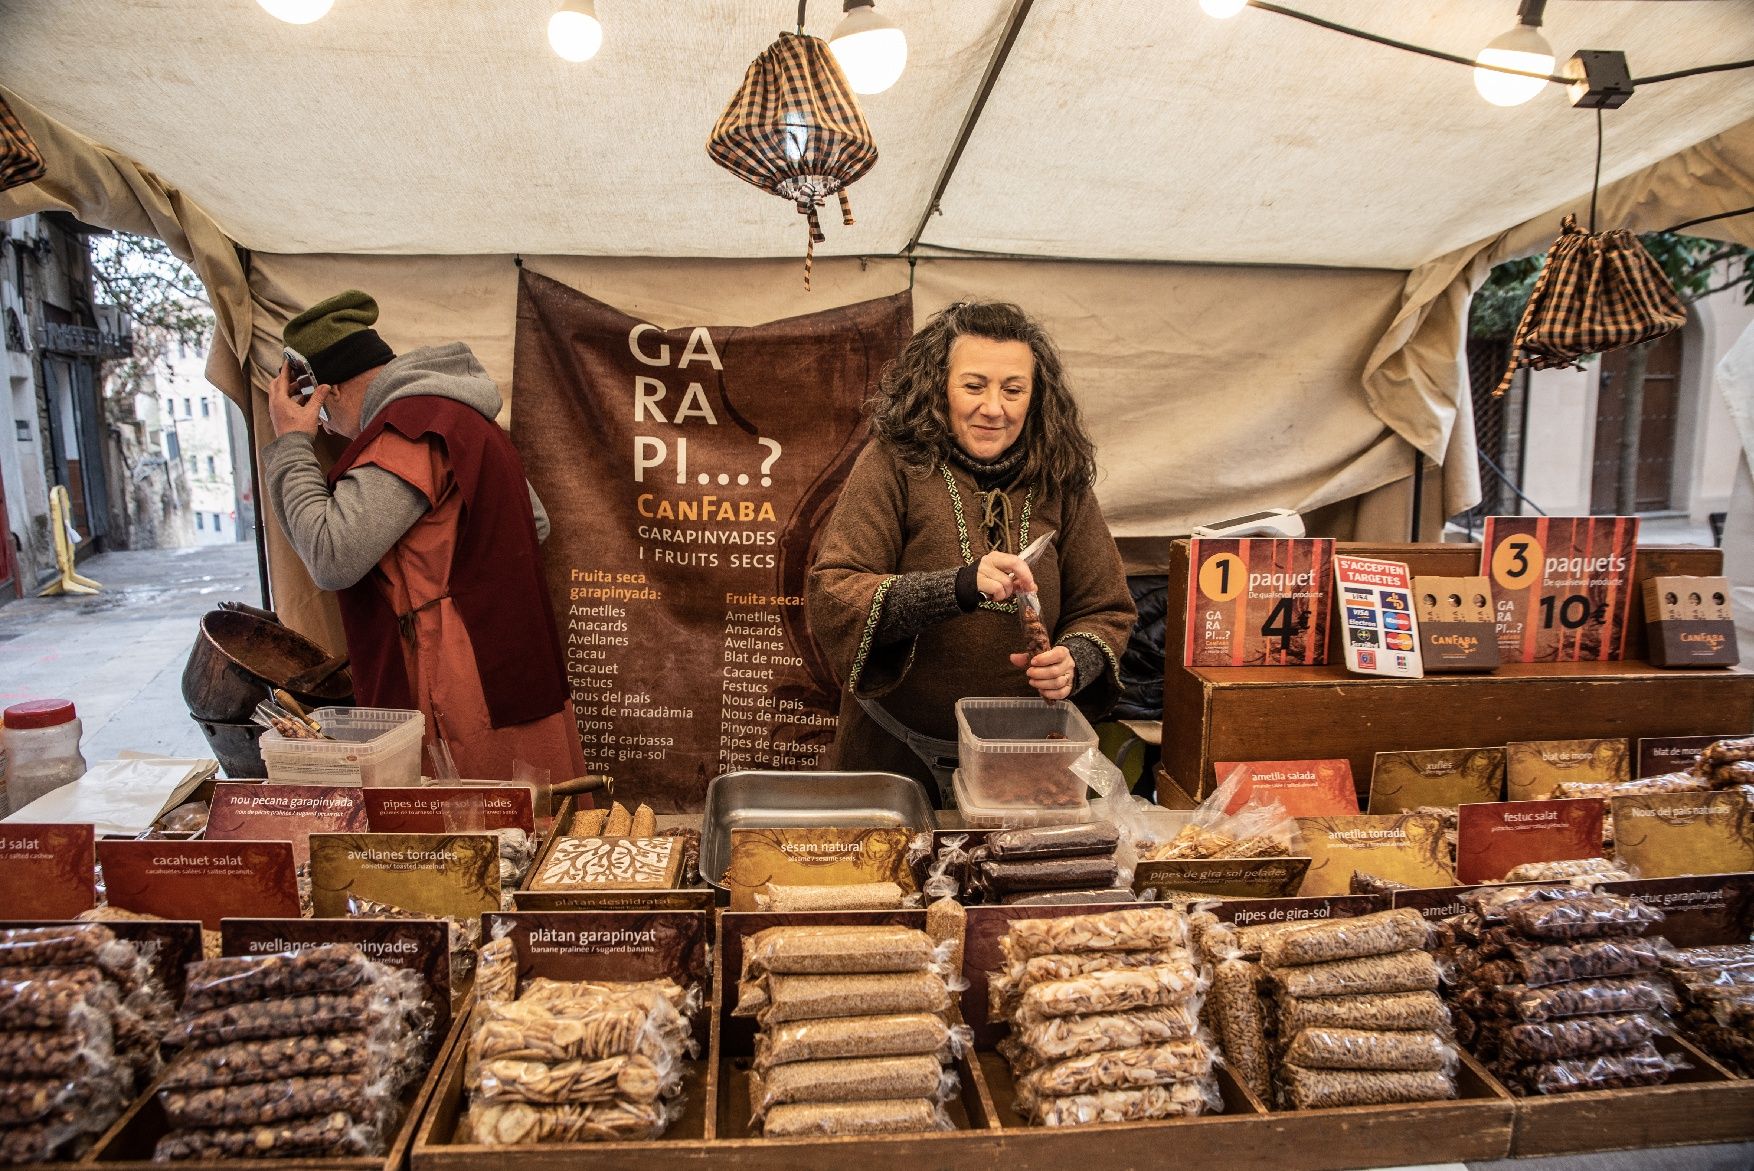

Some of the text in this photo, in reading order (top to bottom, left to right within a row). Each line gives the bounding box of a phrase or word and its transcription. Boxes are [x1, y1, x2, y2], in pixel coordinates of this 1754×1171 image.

[628, 323, 723, 370] GA
[634, 375, 718, 425] RA
[638, 525, 776, 545] GARAPINYADES
[655, 549, 719, 567] FRUITS
[730, 554, 776, 568] SECS
[1506, 543, 1626, 578] 3 paquets
[1340, 560, 1404, 575] S'ACCEPTEN
[571, 569, 646, 584] Fruita seca
[1216, 559, 1316, 594] 1 paquet
[1347, 571, 1401, 586] TARGETES
[1544, 579, 1554, 587] De
[569, 586, 661, 602] garapinyada:
[726, 592, 805, 606] Fruita seca:
[1292, 592, 1324, 600] producte
[569, 604, 626, 617] Ametlles
[1497, 600, 1515, 611] GA
[725, 611, 781, 623] Ametlles
[1206, 611, 1222, 620] GA
[1497, 612, 1512, 622] RA
[568, 618, 628, 631] Anacards
[725, 624, 783, 636] Anacards
[1205, 621, 1221, 630] RA
[567, 633, 629, 646] Avellanes
[724, 637, 784, 651] Avellanes
[567, 647, 606, 659] Cacau
[724, 651, 803, 667] Blat de moro
[567, 661, 618, 674] Cacauet
[723, 666, 774, 680] Cacauet
[567, 675, 613, 688] Festucs
[722, 680, 768, 693] Festucs
[601, 691, 621, 703] del
[625, 692, 650, 706] país
[722, 694, 754, 706] Nous
[757, 696, 776, 708] del
[572, 704, 694, 719] ous de macadàmia
[721, 708, 839, 727] Nous de macadàmi
[577, 719, 613, 732] nyons
[721, 721, 768, 737] Pinyons
[600, 733, 616, 744] de
[619, 734, 674, 746] carbassa
[720, 735, 826, 753] Pipes de carbassa
[600, 747, 615, 757] de
[618, 748, 666, 761] gira-sol
[719, 749, 819, 767] Pipes de gira-sol
[1252, 771, 1316, 781] ametlla salada
[230, 797, 353, 808] nou pecana garapinyada
[383, 800, 412, 811] pipes
[414, 799, 427, 808] de
[1504, 811, 1558, 822] festuc salat
[1632, 807, 1655, 817] Nous
[1328, 828, 1406, 839] ametlla torrada
[9, 837, 40, 850] salat
[781, 840, 863, 852] sèsam natural
[153, 854, 243, 866] cacahuet salat
[347, 848, 458, 860] avellanes torrades
[1234, 906, 1331, 925] pipes de gira-sol
[1422, 903, 1466, 917] ametlla
[529, 928, 656, 945] plàtan garapinyat
[250, 938, 316, 952] avellanes
[531, 945, 559, 953] banane
[596, 945, 626, 954] sugared
[627, 945, 654, 953] banana
